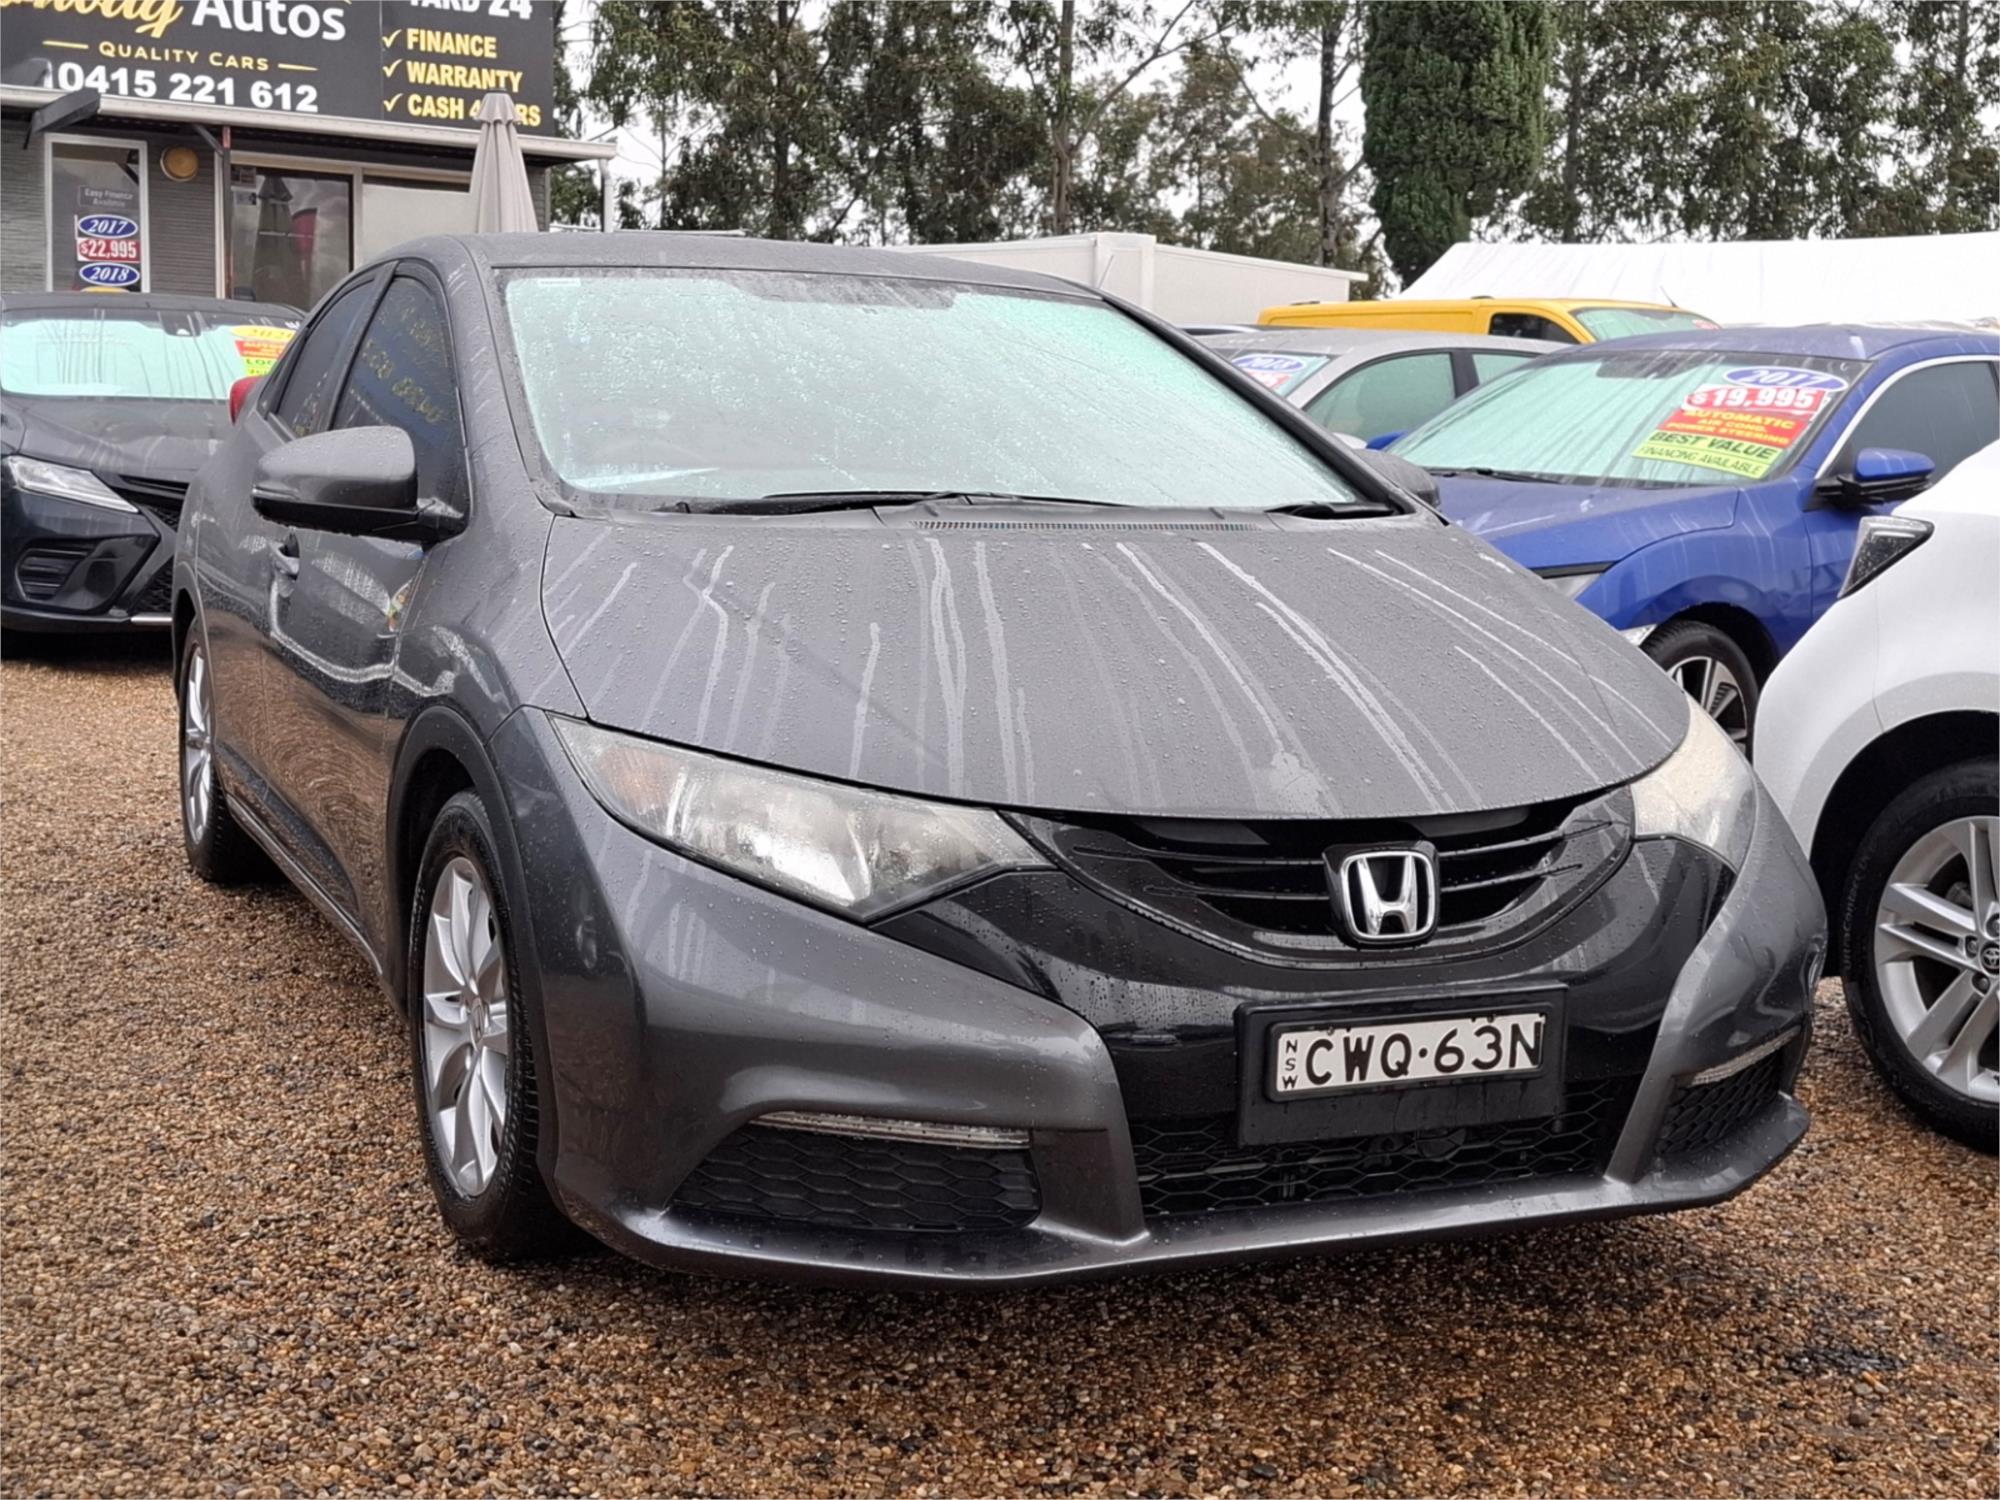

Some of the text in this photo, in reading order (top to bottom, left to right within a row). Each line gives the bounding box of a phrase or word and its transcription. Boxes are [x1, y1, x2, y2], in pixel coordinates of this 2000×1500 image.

[192, 0, 345, 40] Autos
[406, 28, 498, 58] FINANCE
[99, 41, 269, 71] QUALITY CARS
[58, 62, 318, 113] 0415 221 612
[406, 61, 523, 93] WARRANTY
[407, 93, 465, 120] CASH
[88, 219, 128, 234] 2017
[80, 240, 137, 258] $22,995
[89, 266, 129, 281] 2018
[1740, 369, 1831, 386] 2017
[1683, 410, 1796, 429] AUTOMATIC
[1697, 419, 1723, 427] AIR
[1665, 421, 1791, 444] POWER STEERING
[1649, 431, 1778, 459] BEST VALUE
[1699, 454, 1762, 475] AVAILABLE
